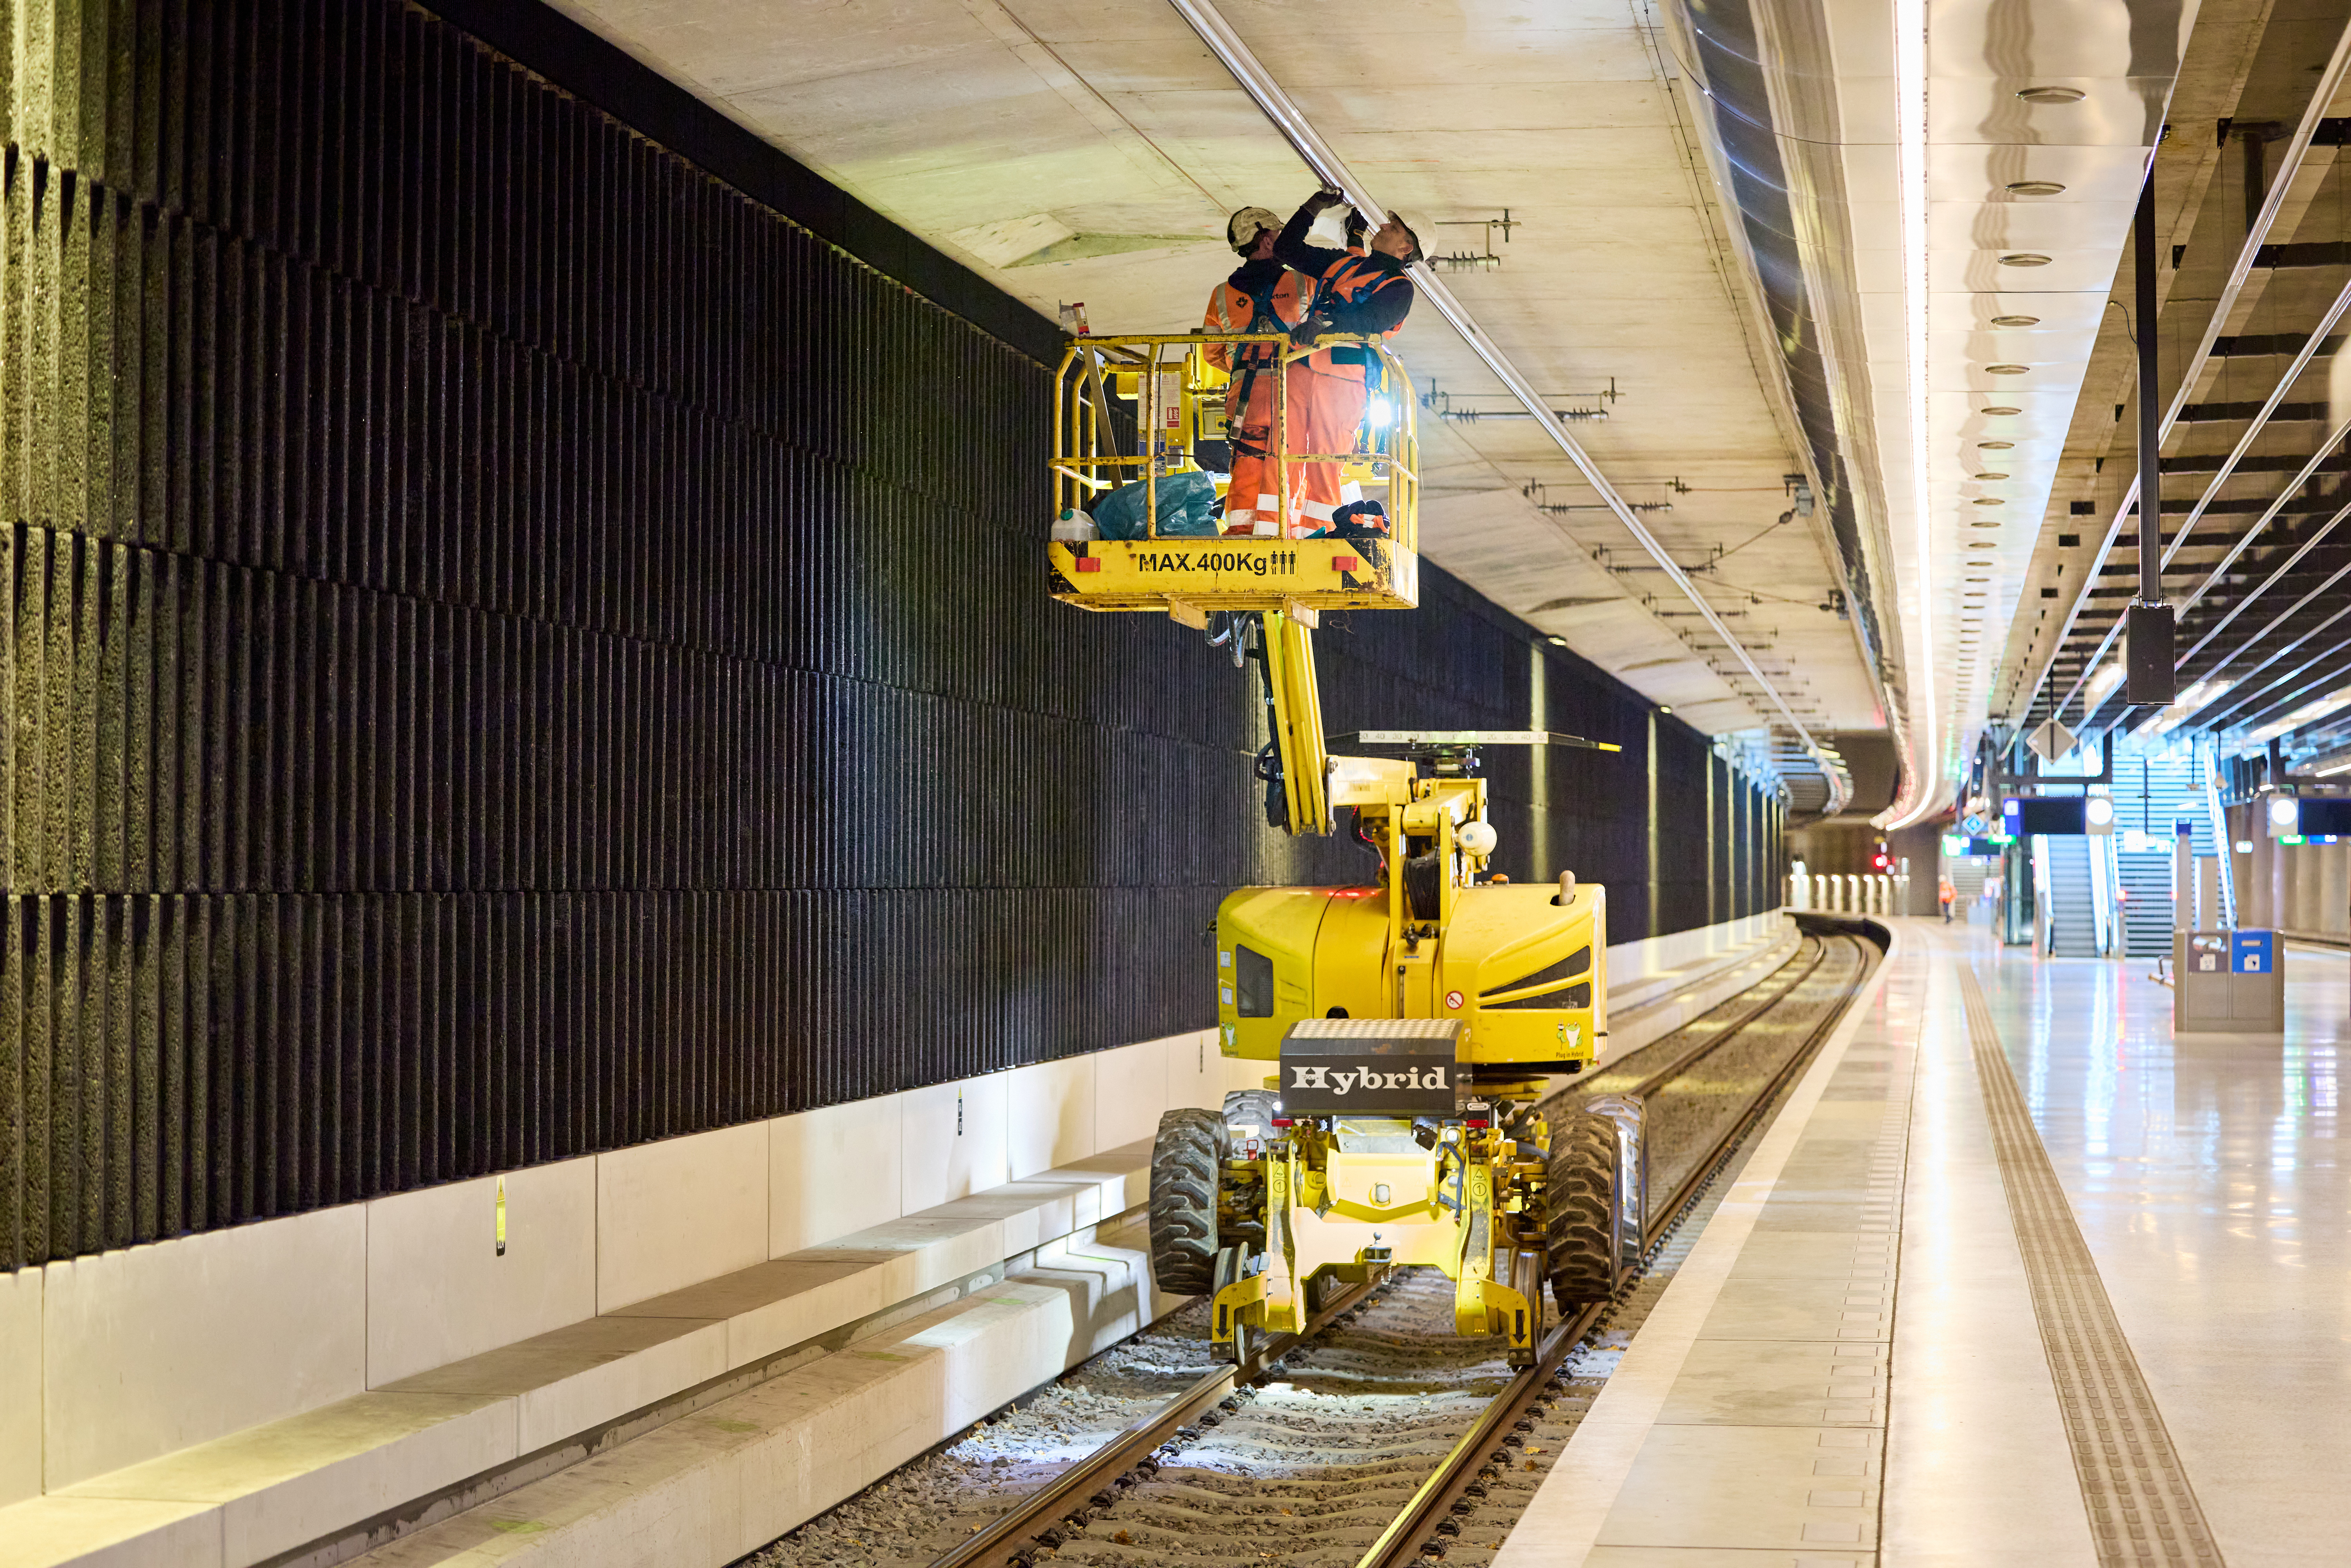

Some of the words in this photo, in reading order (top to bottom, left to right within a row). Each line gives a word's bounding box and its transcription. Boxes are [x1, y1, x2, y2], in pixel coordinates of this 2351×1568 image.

[1139, 553, 1266, 576] MAX.400Kg
[1290, 1066, 1450, 1095] Hybrid
[1277, 1181, 1281, 1191] 1
[1477, 1185, 1481, 1194] 1
